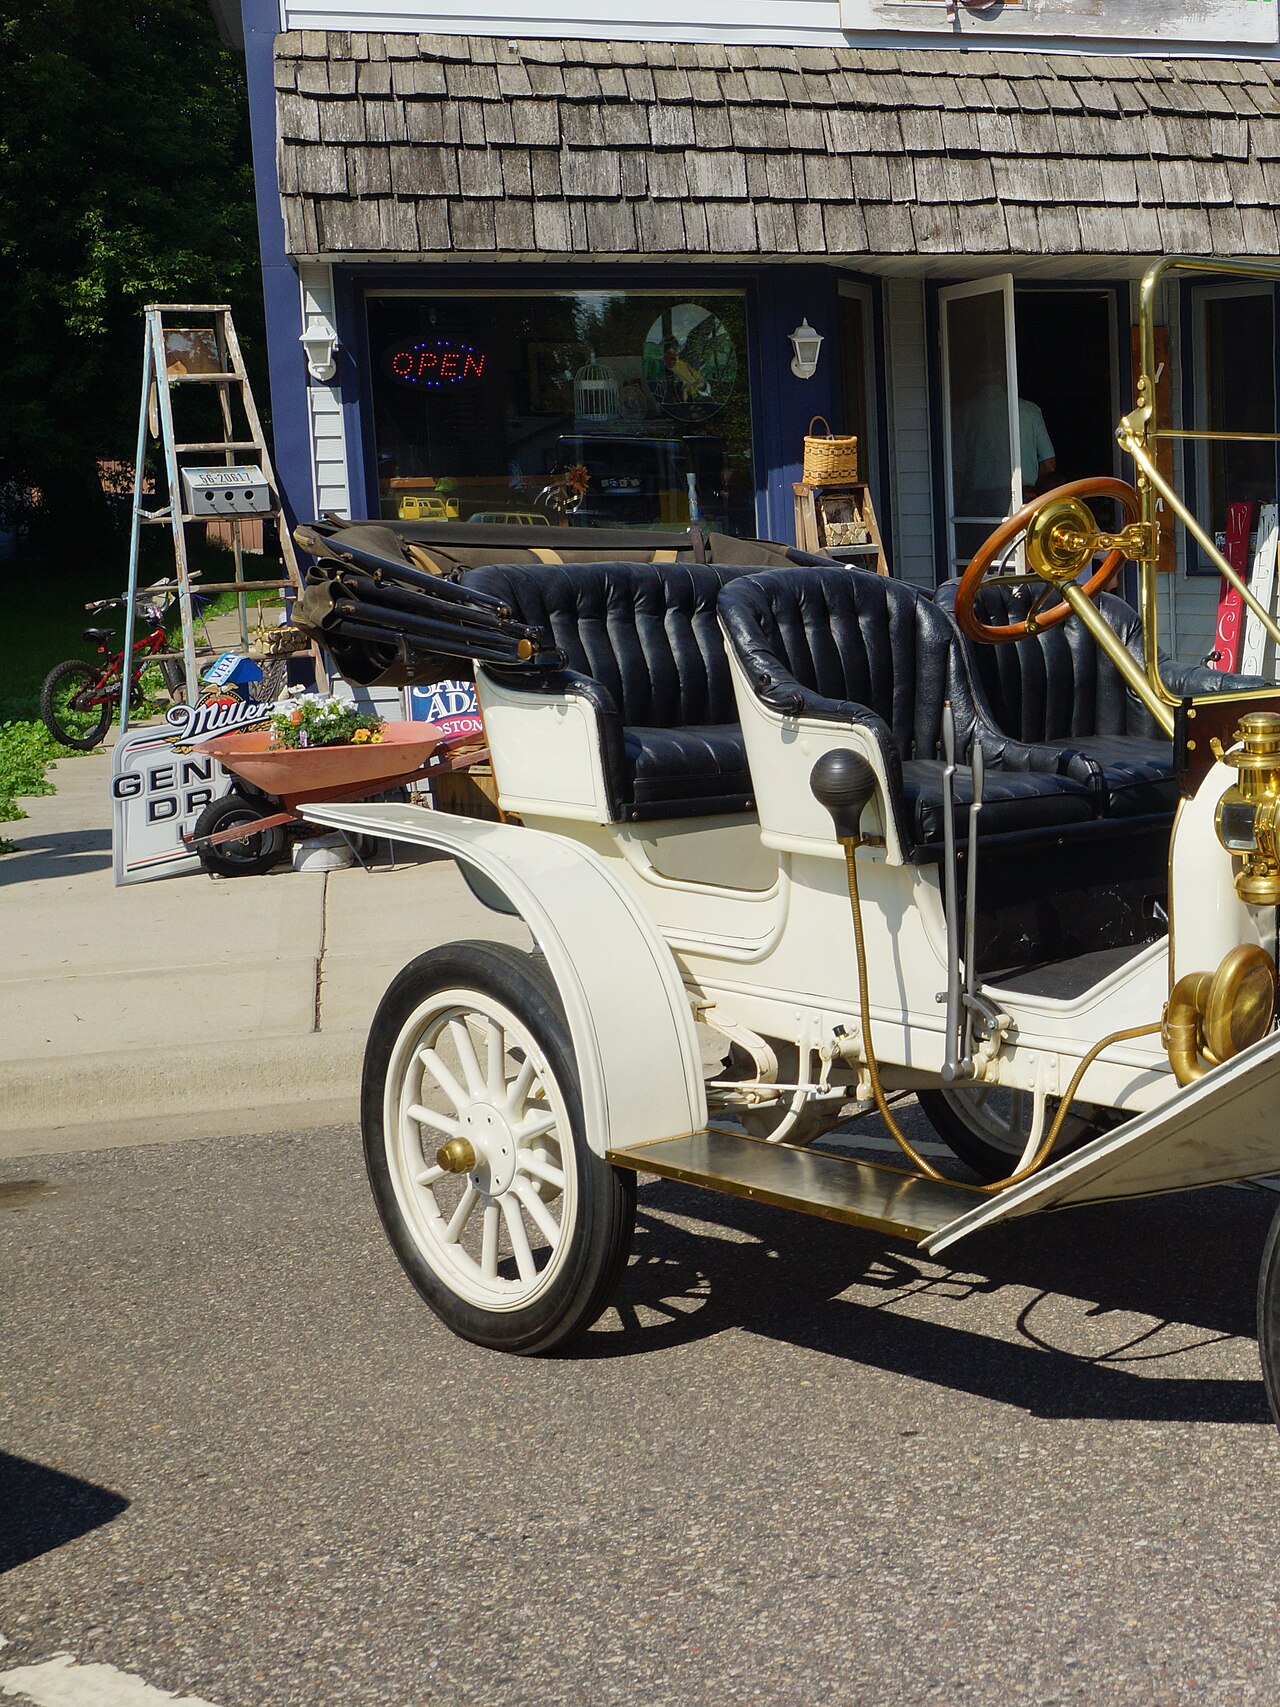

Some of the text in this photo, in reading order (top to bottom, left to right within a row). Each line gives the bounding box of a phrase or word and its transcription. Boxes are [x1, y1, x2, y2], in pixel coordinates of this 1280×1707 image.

[393, 352, 485, 377] OPEN
[166, 701, 275, 741] Miller
[113, 758, 235, 798] GEN
